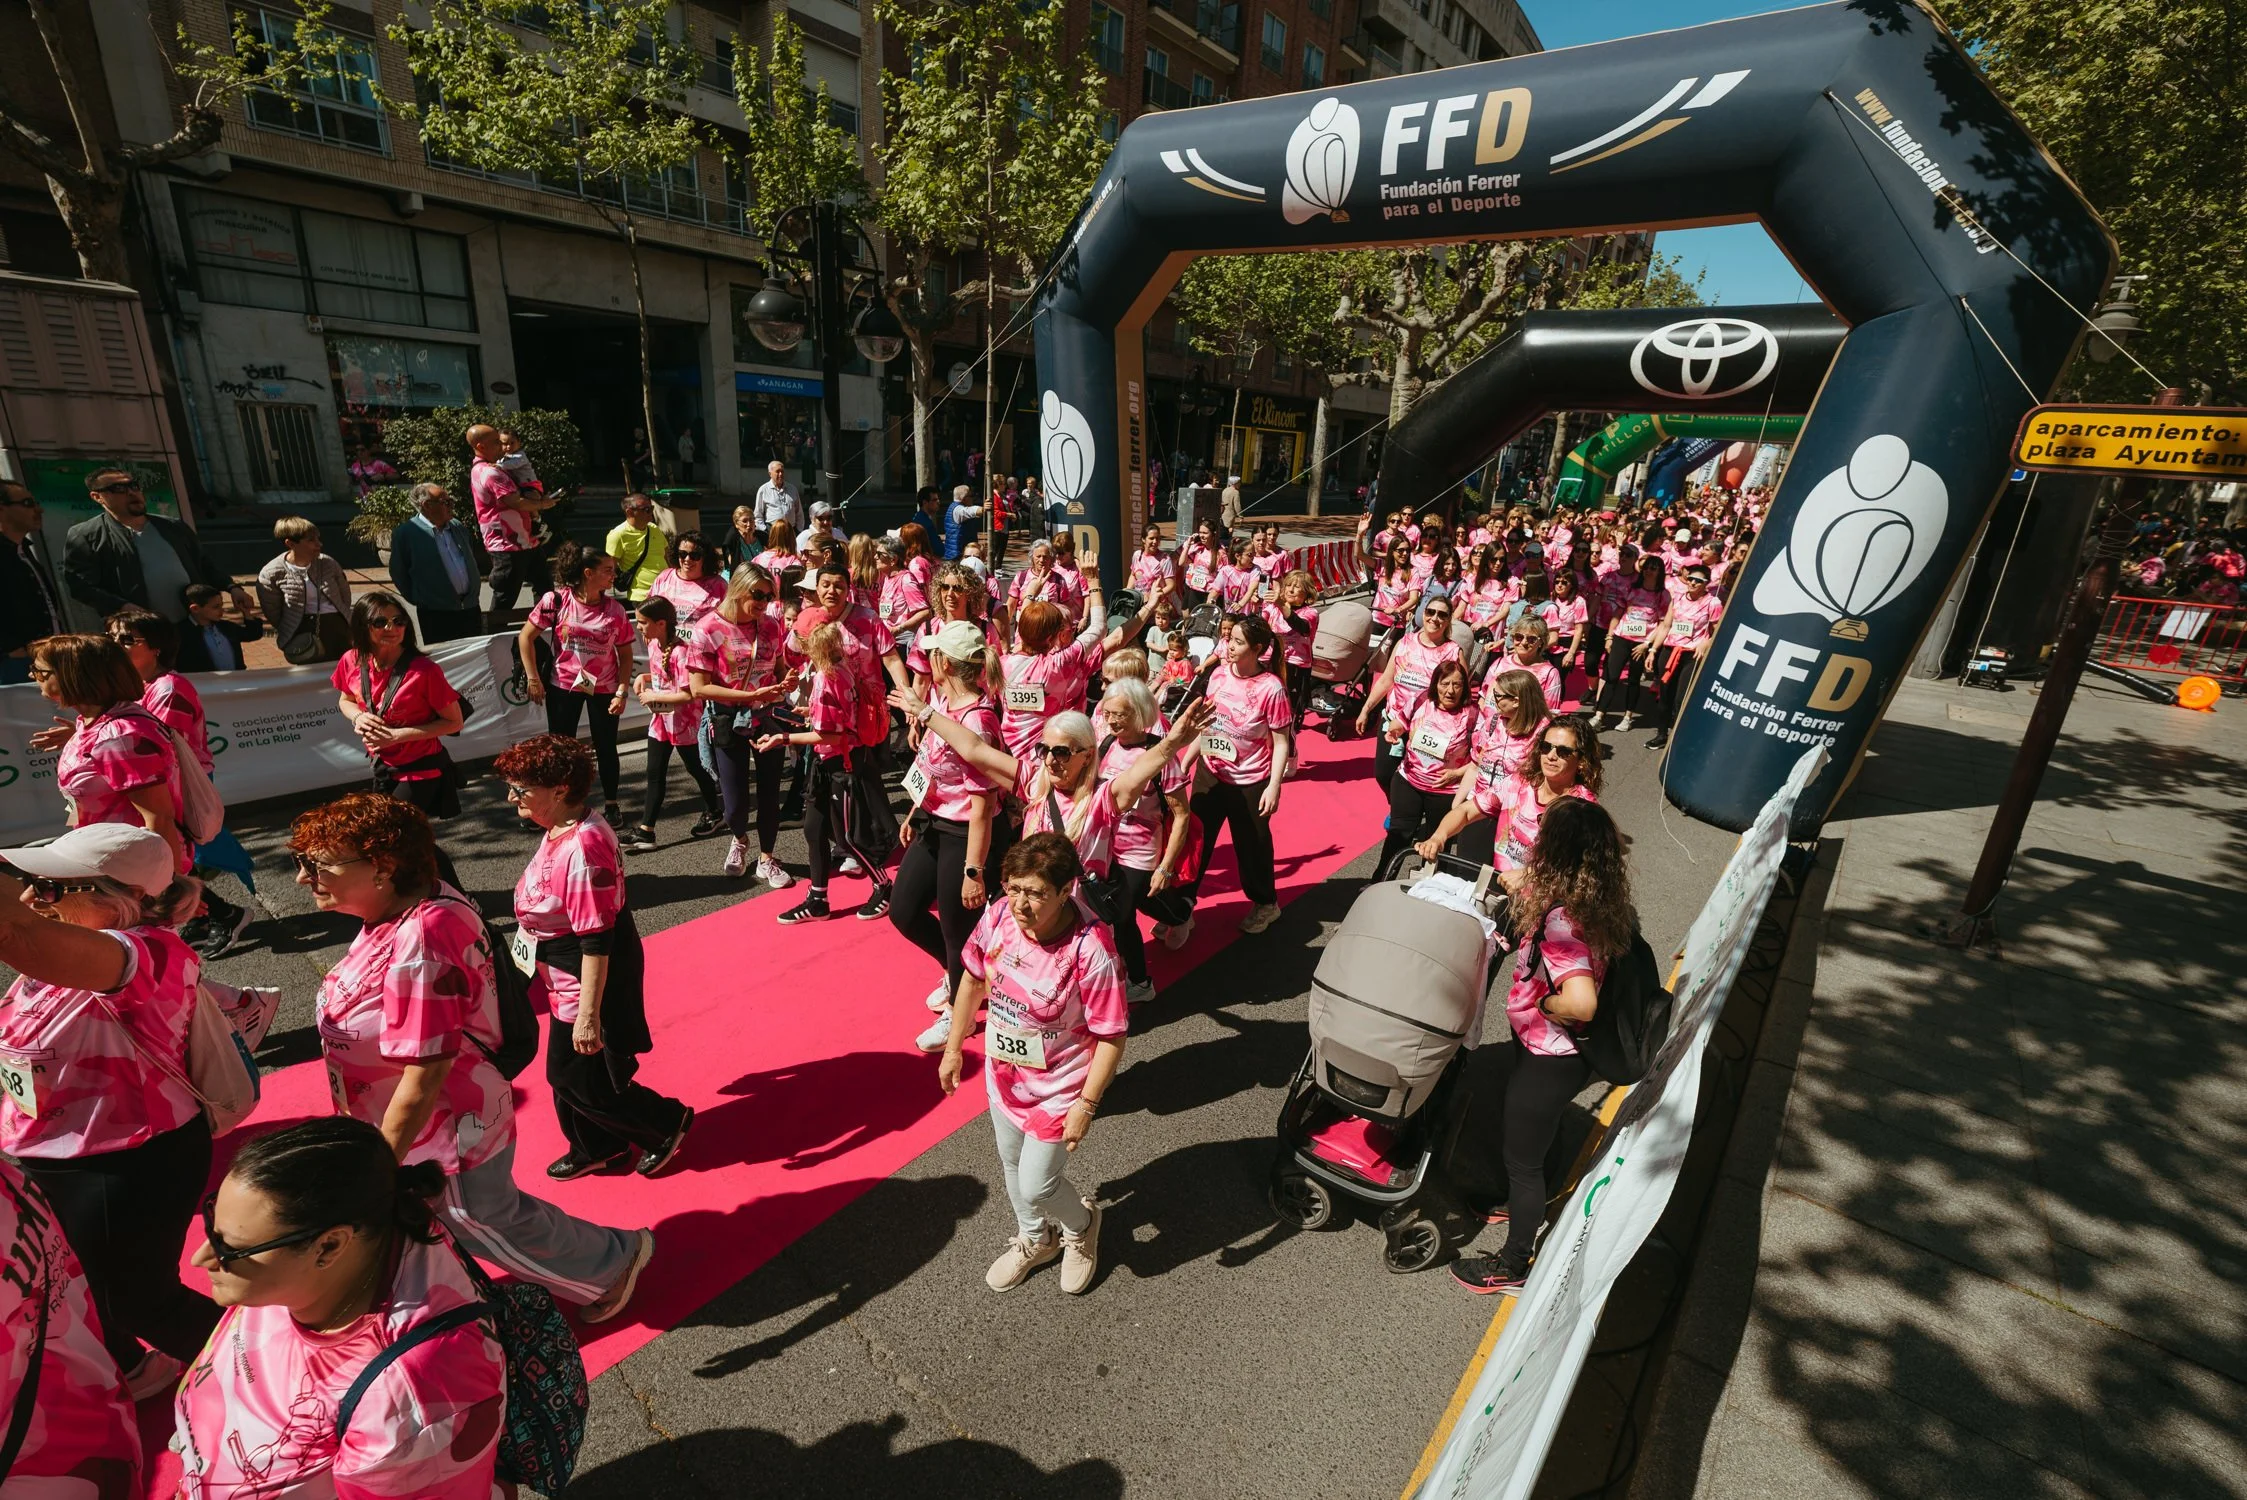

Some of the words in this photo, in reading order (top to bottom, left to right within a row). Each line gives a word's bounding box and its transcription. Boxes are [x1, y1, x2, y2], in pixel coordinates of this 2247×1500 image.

[1380, 87, 1532, 176] FFD
[1380, 177, 1463, 200] Fundación
[1468, 173, 1521, 191] Ferrer
[1383, 203, 1420, 220] para
[1428, 199, 1443, 214] el
[1452, 193, 1521, 213] Deporte
[768, 379, 804, 390] ANAGAN
[2036, 422, 2240, 442] aparcamiento:
[2026, 442, 2096, 459] plaza
[1676, 624, 1689, 632] 1373
[1718, 623, 1872, 712] FFD
[1011, 692, 1038, 704] 3395
[1710, 680, 1787, 721] Fundación
[1790, 711, 1844, 732] Ferrer
[232, 712, 294, 729] asociación
[235, 727, 274, 738] contra
[276, 723, 287, 732] el
[289, 719, 326, 731] cáncer
[1703, 697, 1734, 720] para
[1740, 714, 1758, 730] el
[1764, 721, 1836, 748] Deporte
[238, 741, 253, 749] en
[256, 738, 270, 746] La
[272, 733, 301, 744] Rioja
[1208, 738, 1231, 752] 1354
[32, 770, 52, 779] en
[911, 770, 926, 794] 6794
[994, 972, 1005, 985] XI
[991, 985, 1028, 1013] Carrera
[1007, 1007, 1016, 1018] la
[996, 1032, 1028, 1056] 538
